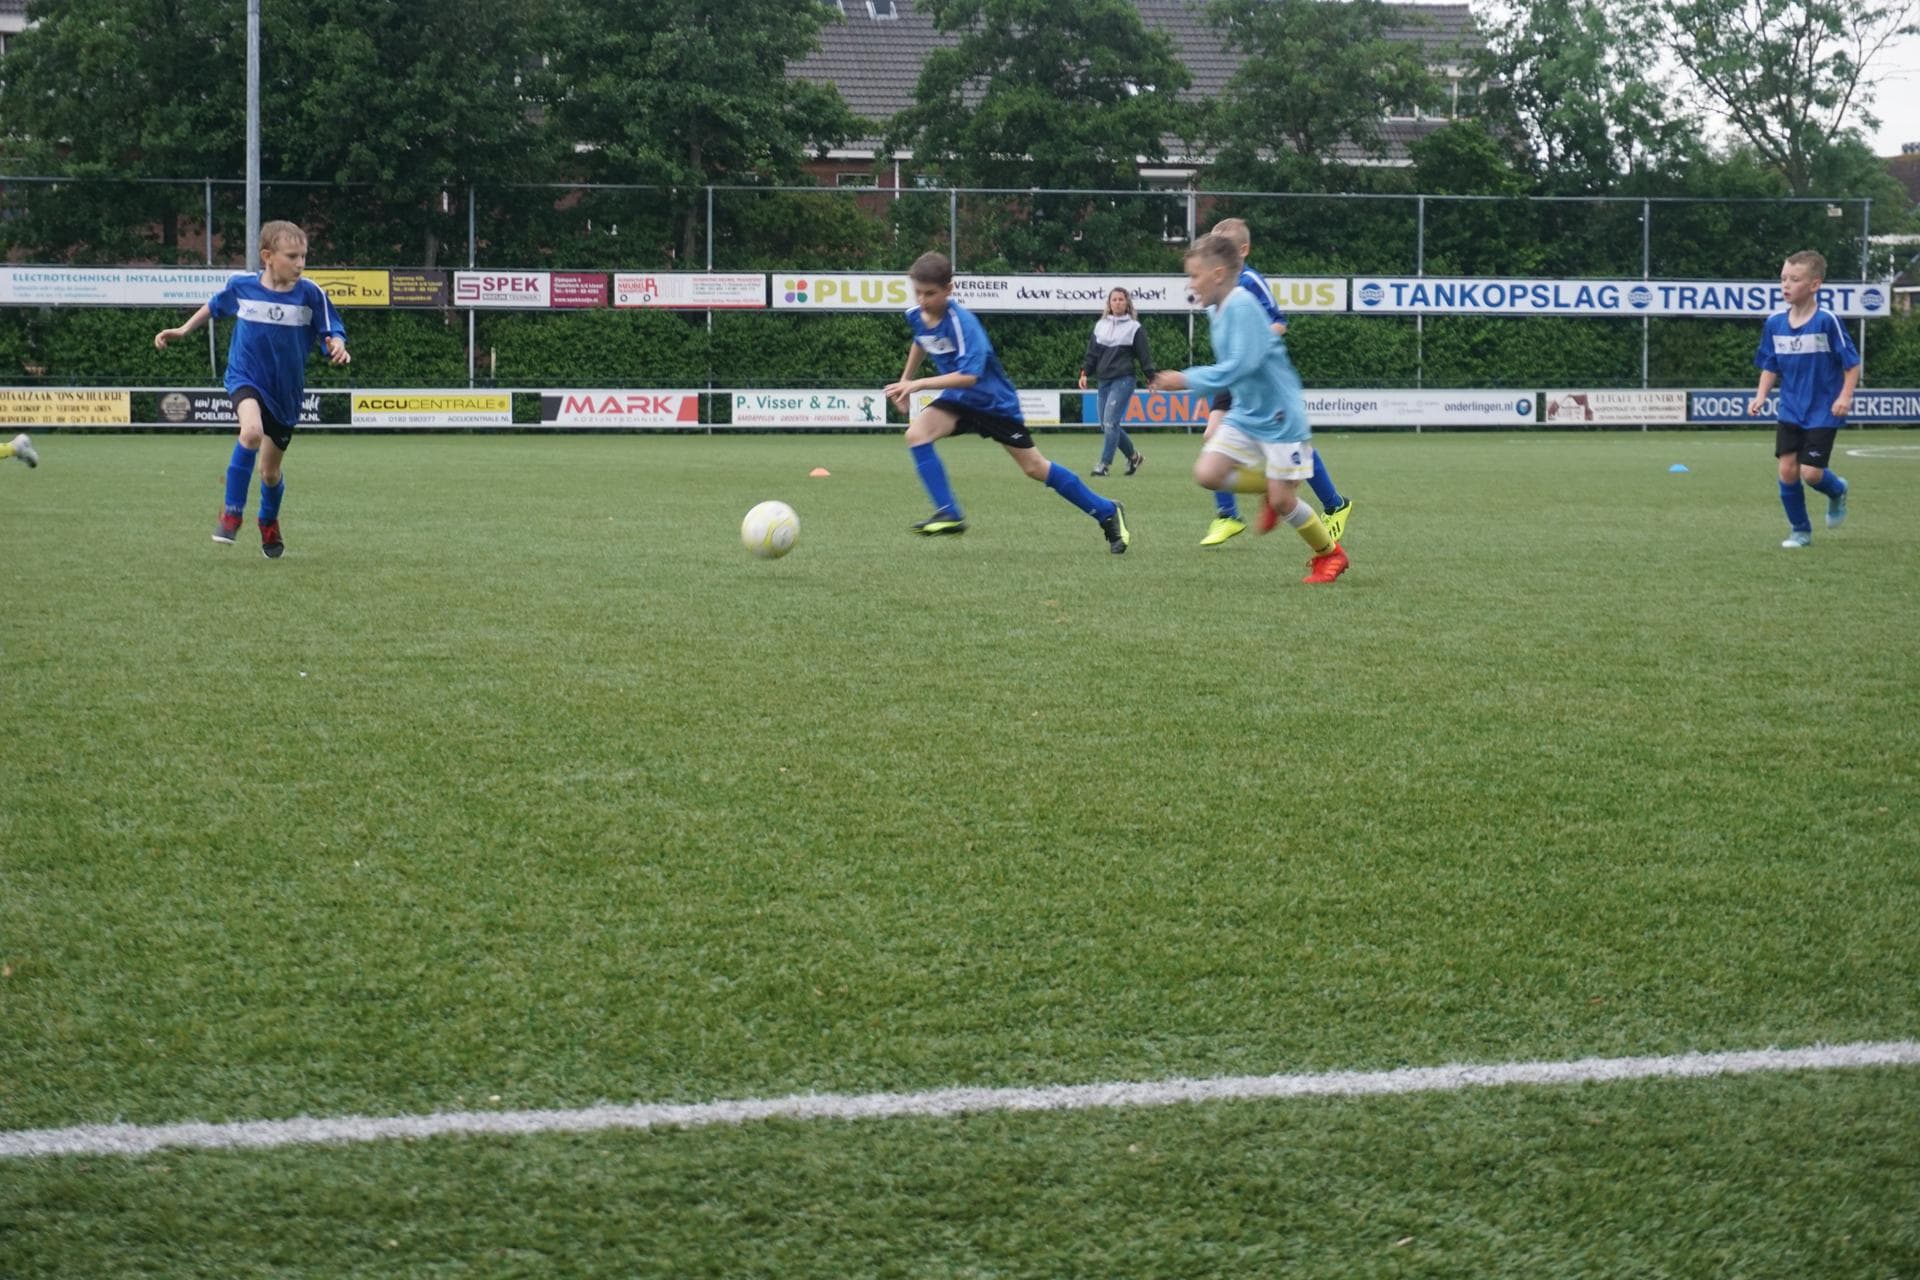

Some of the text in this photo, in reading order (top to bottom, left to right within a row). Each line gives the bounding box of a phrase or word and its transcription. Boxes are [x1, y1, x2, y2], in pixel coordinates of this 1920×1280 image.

[12, 273, 228, 283] ELECTROTECHNISCH INSTALLATIEBEDRI
[483, 276, 539, 292] SPEK
[953, 280, 1009, 290] VERGEER
[326, 285, 357, 297] pek
[814, 279, 907, 304] PLUS
[1016, 286, 1167, 301] daar scoort eker!
[1271, 282, 1336, 306] LUS
[1389, 283, 1621, 309] TANKOPSLAG
[1658, 286, 1856, 311] TRANSPRT
[358, 399, 495, 410] ACCUCENTRALE
[564, 395, 674, 414] MARK
[736, 395, 850, 410] P. Visser & Zn.
[1125, 394, 1210, 422] AGNA
[1444, 398, 1513, 414] onderlingen.nl
[1693, 397, 1743, 417] KOOS
